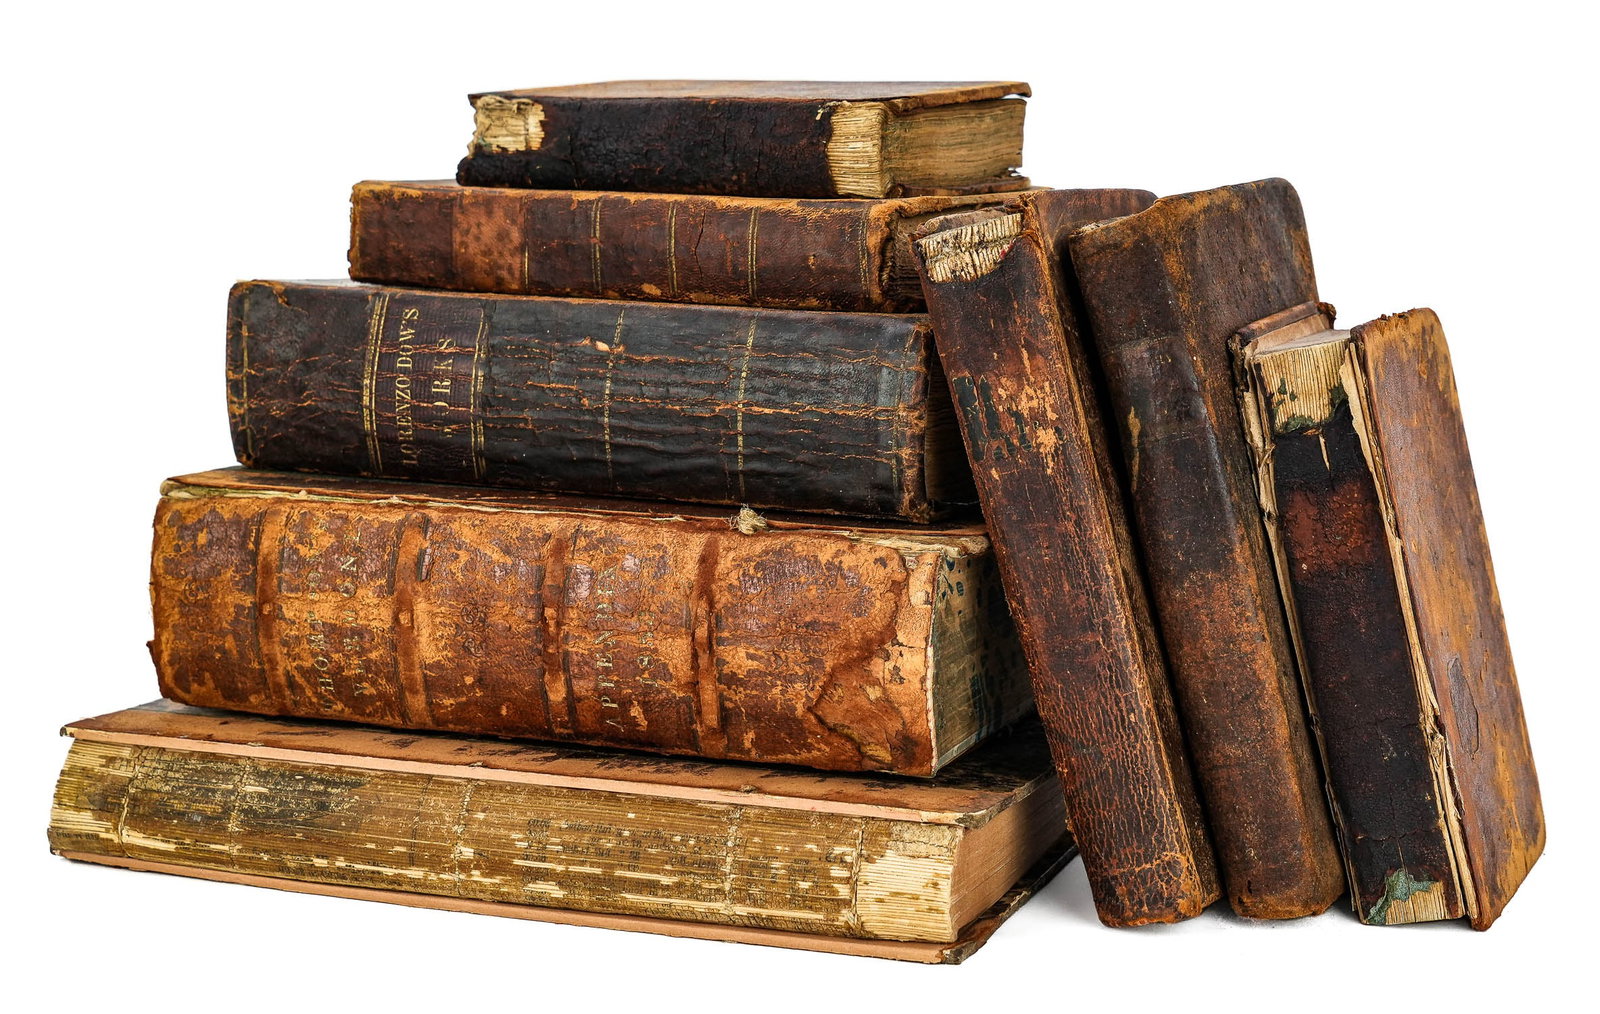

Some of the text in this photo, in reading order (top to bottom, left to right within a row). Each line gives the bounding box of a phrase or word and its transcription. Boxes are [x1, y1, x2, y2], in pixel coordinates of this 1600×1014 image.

[395, 308, 420, 465] LORENZO DOW'S
[594, 566, 624, 733] APPENDIX
